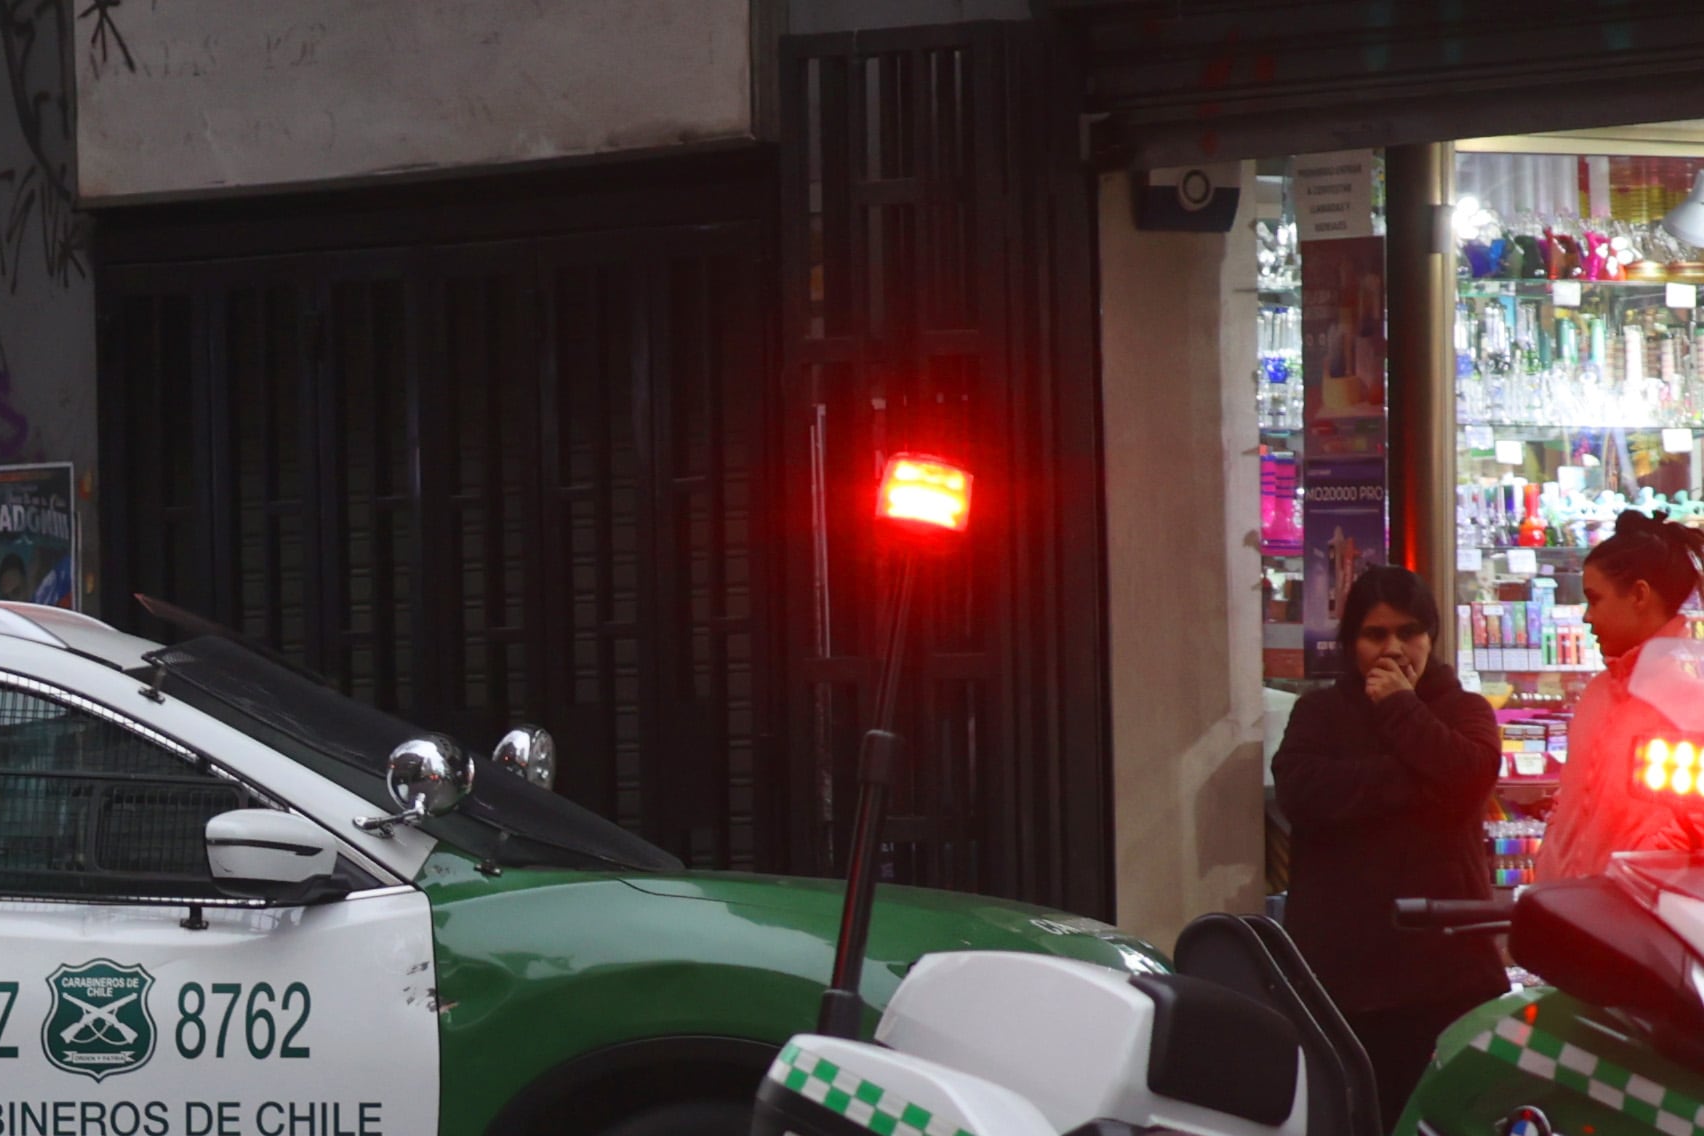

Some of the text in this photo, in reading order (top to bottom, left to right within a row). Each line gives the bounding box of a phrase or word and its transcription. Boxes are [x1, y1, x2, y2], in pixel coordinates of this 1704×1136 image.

[1358, 485, 1383, 501] PRO
[61, 977, 139, 989] CARABINEROS DE
[87, 987, 113, 998] CHILE
[175, 981, 312, 1060] 8762
[185, 1102, 242, 1136] DE
